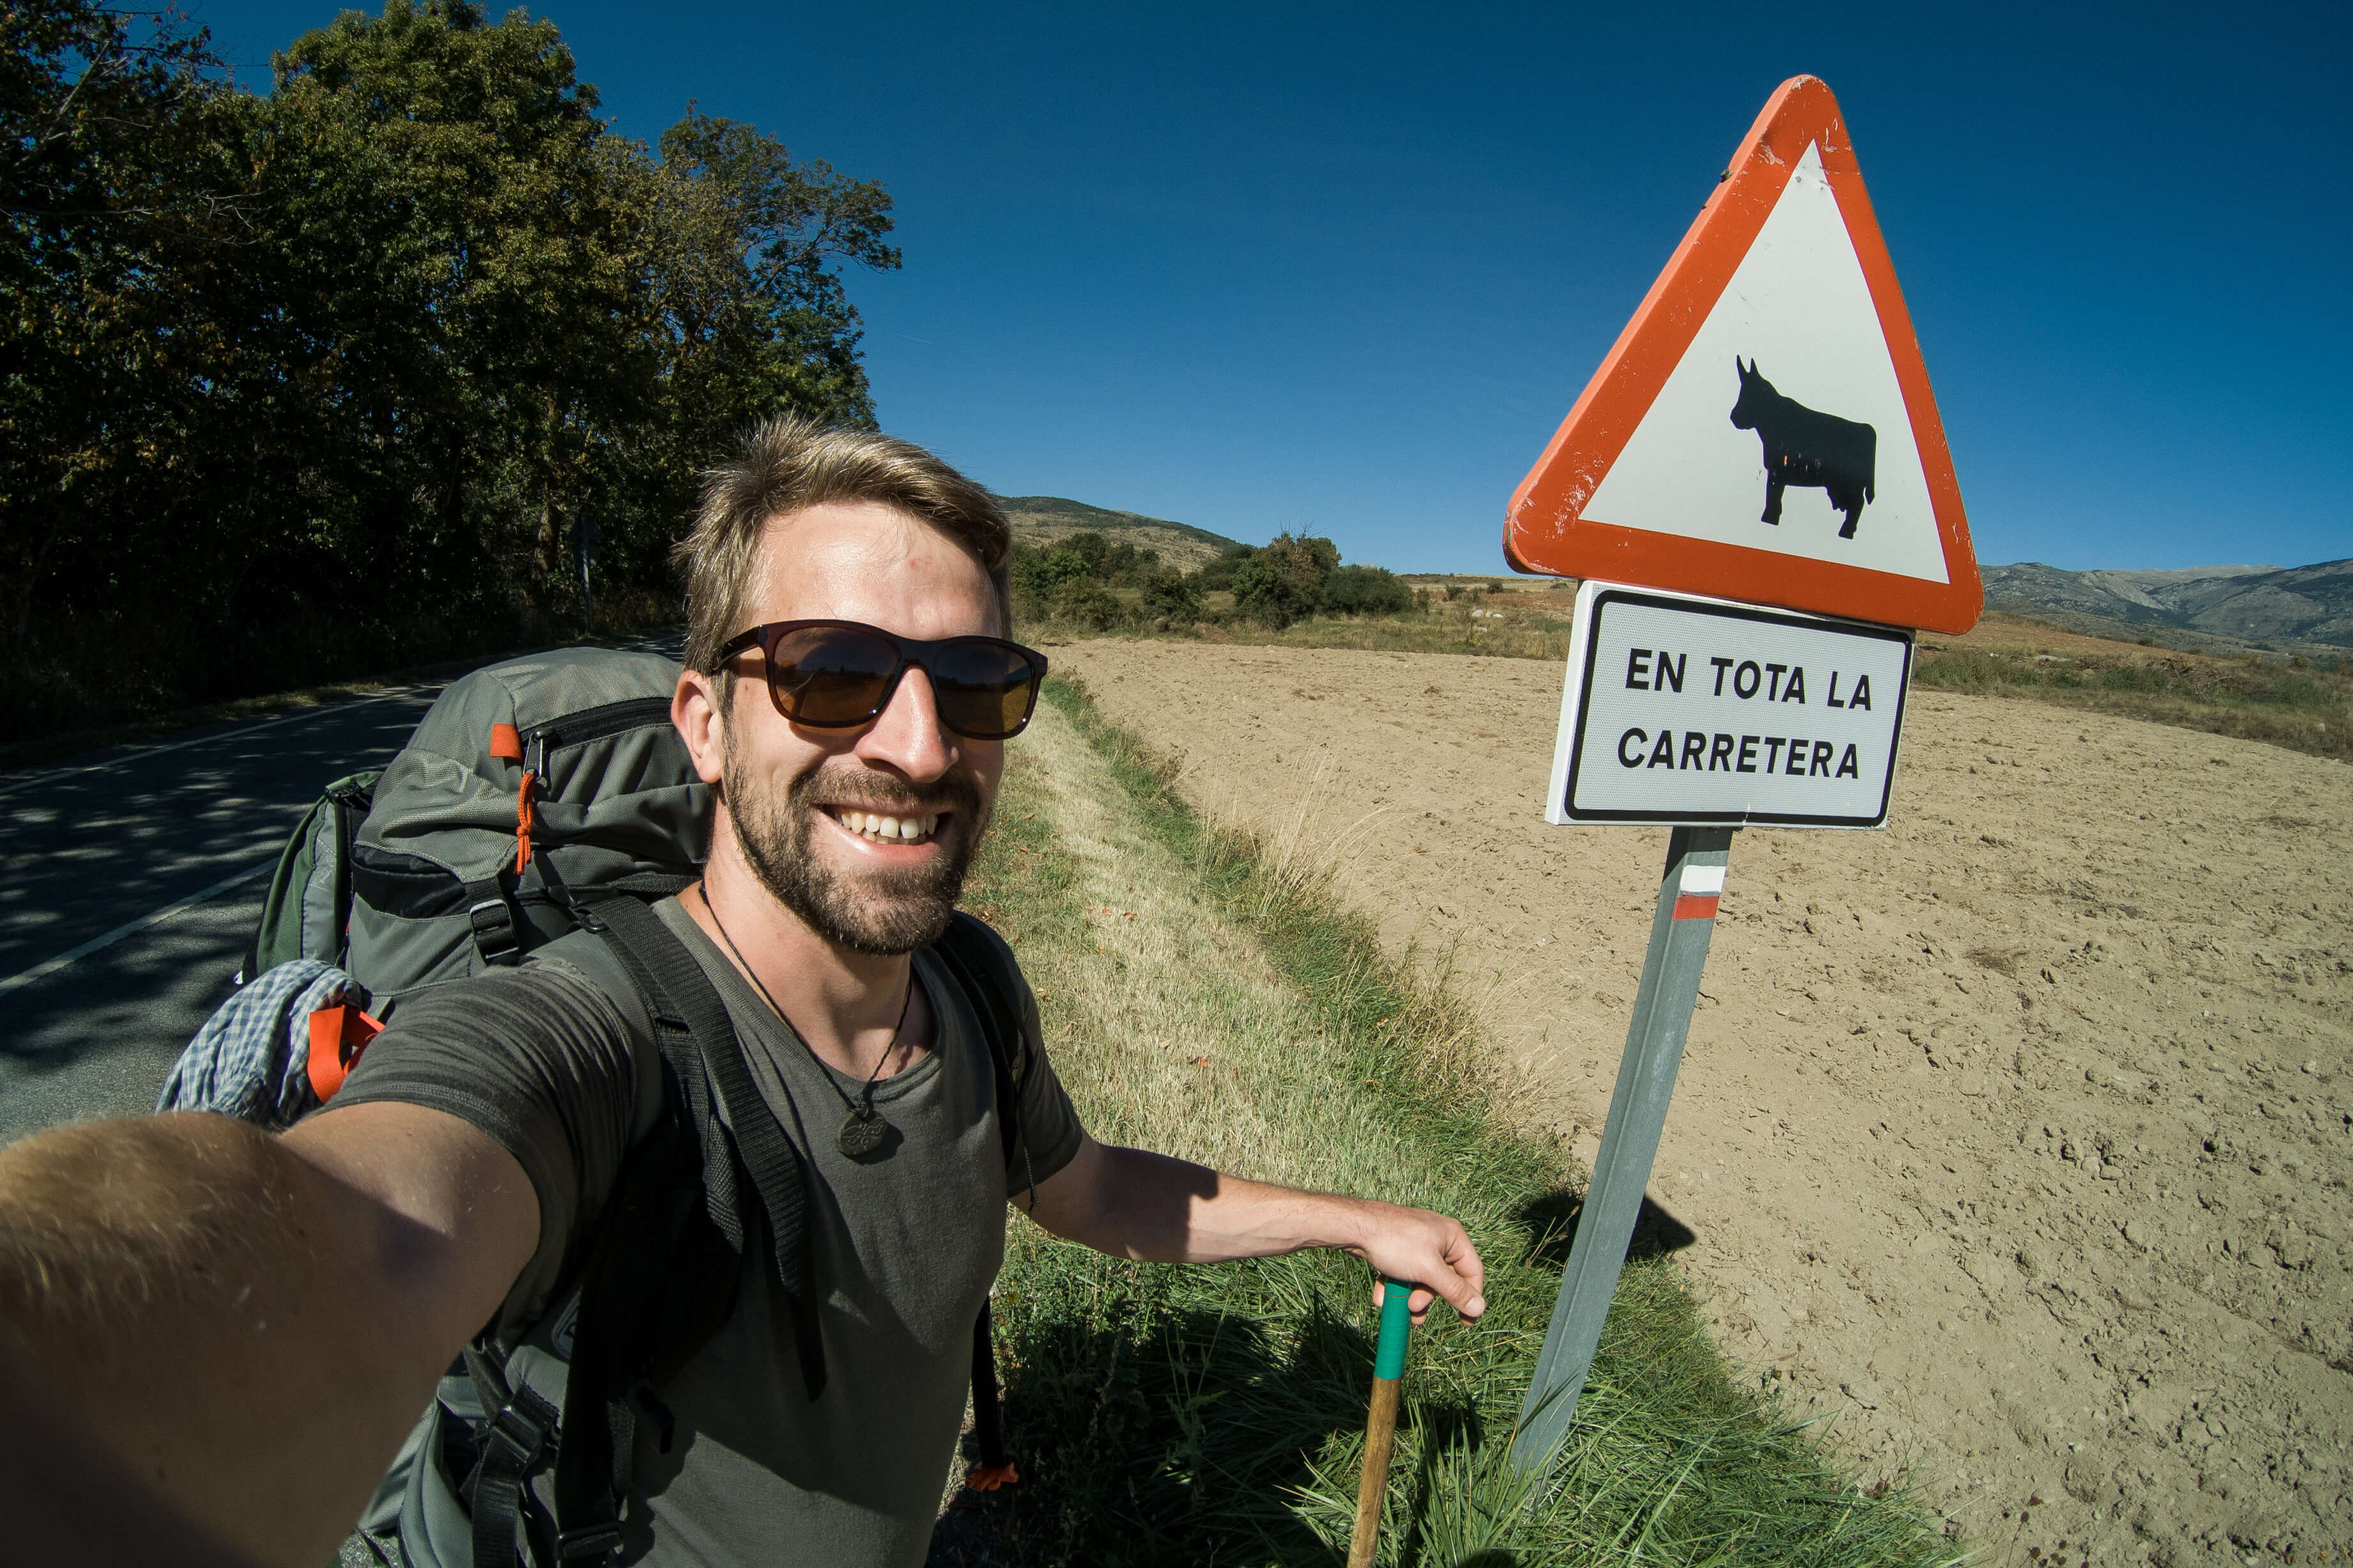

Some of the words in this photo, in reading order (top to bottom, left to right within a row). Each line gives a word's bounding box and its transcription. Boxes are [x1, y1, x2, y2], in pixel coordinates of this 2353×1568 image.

[1625, 648, 1687, 693] EN
[1710, 657, 1806, 704] TOTA
[1827, 671, 1872, 712] LA
[1617, 727, 1859, 779] CARRETERA
